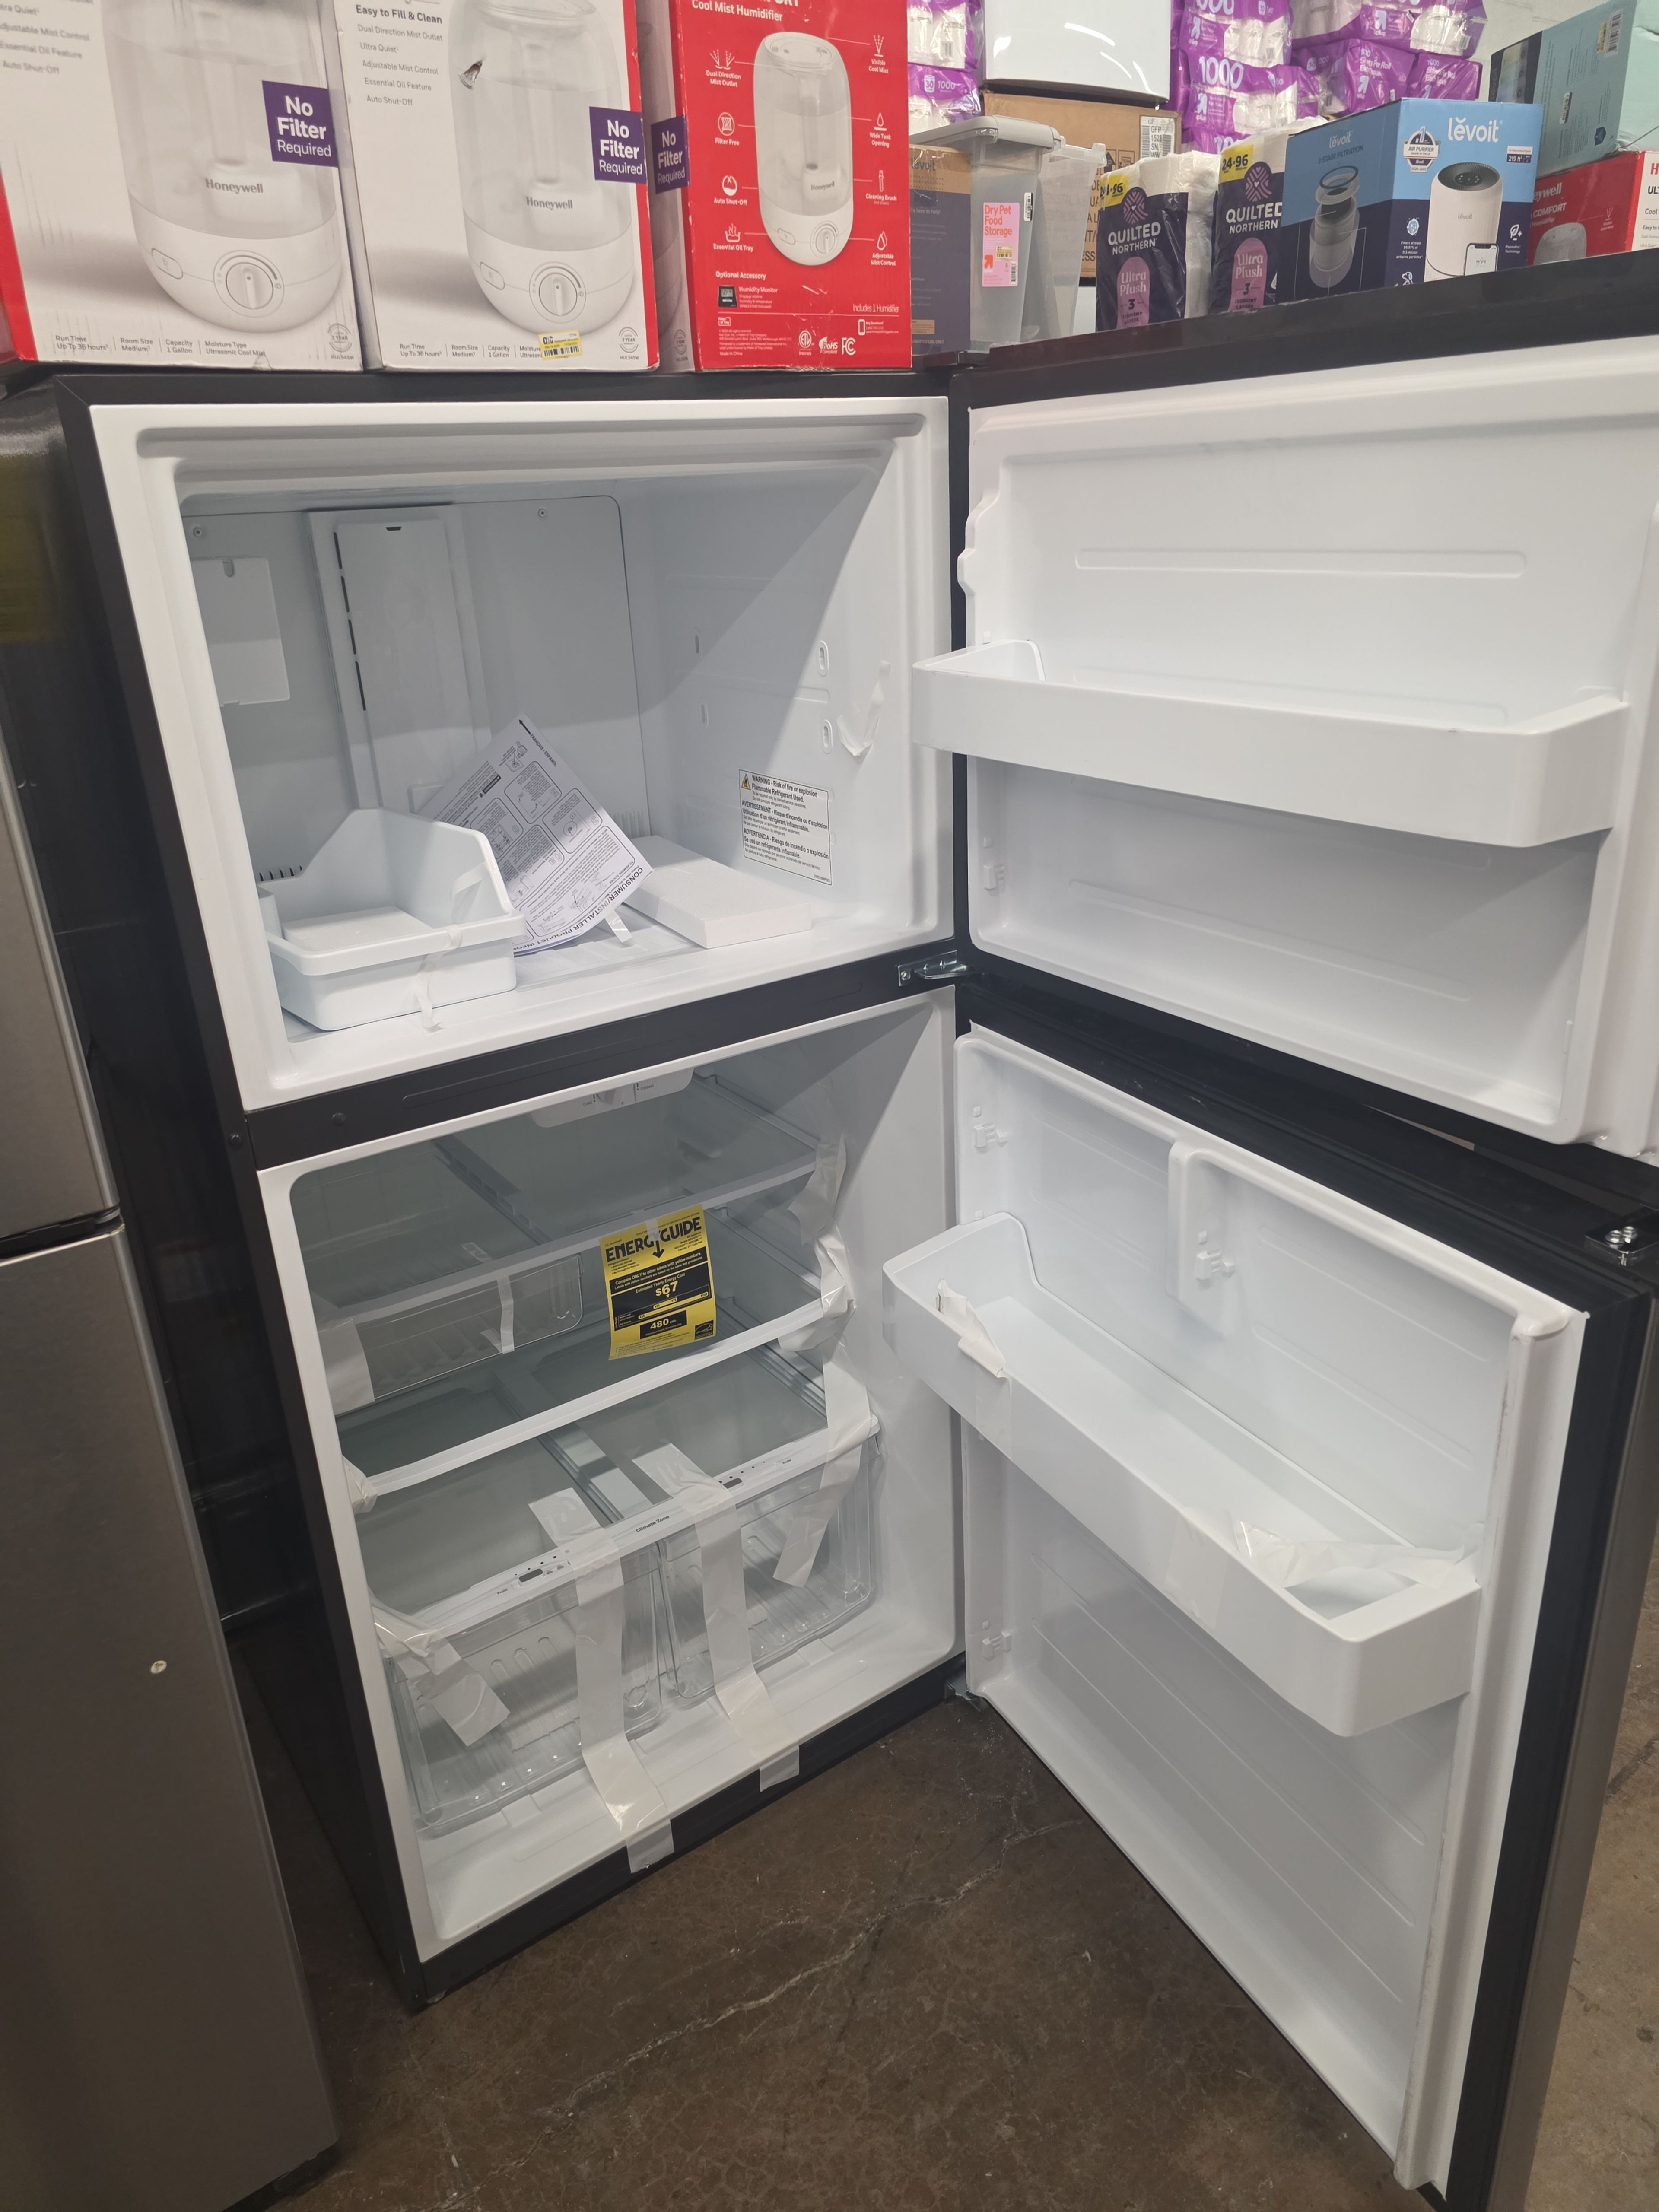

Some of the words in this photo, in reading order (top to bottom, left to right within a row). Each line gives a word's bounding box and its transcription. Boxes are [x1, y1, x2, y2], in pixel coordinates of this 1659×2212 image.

[356, 4, 377, 18] Easy
[391, 9, 406, 19] Fill
[408, 11, 415, 20] &
[417, 13, 442, 24] Clean
[692, 0, 713, 11] Cool
[715, 2, 734, 14] Mist
[737, 5, 783, 22] Humidifier
[358, 24, 374, 33] Dual
[375, 26, 405, 37] Direction
[407, 31, 421, 39] Mist
[423, 32, 442, 41] Outlet
[360, 42, 377, 51] Ultra
[362, 60, 397, 70] Adjustable
[415, 66, 438, 75] Control
[718, 70, 741, 79] Direction
[1199, 56, 1244, 89] 1000
[365, 77, 395, 87] Essential
[407, 83, 431, 91] Feature
[938, 81, 955, 89] 1000
[285, 96, 313, 116] No
[384, 97, 413, 106] Shut-Off
[277, 117, 326, 139] Filter
[607, 120, 629, 138] No
[662, 130, 676, 148] No
[872, 140, 889, 148] Opening
[277, 140, 331, 157] Required
[600, 140, 639, 159] Filter
[1339, 145, 1363, 159] FILTRATION
[658, 151, 683, 169] Filter
[599, 160, 642, 175] Required
[658, 167, 685, 185] Required
[205, 178, 263, 194] Honeywell
[811, 181, 834, 191] Honeywell
[526, 197, 573, 211] Honeywell
[866, 193, 884, 201] Cleaning
[985, 205, 998, 216] Dry
[1000, 205, 1011, 214] Pet
[1534, 202, 1567, 217] COMFORT
[985, 216, 1002, 225] Food
[1230, 219, 1278, 234] NORTHERN
[985, 226, 1012, 238] Storage
[1108, 222, 1161, 245] QUILTED
[1112, 238, 1156, 255] NORTHERN
[1237, 254, 1263, 266] Ultra
[740, 272, 766, 281] Accessory
[1121, 272, 1146, 284] Ultra
[1235, 267, 1262, 279] Plush
[1120, 282, 1146, 296] Plush
[1243, 283, 1250, 295] 3
[853, 304, 871, 312] Includes
[873, 304, 876, 312] 1
[877, 304, 899, 313] Humidifier
[1128, 299, 1135, 310] 3
[752, 775, 770, 785] WARNING
[799, 788, 817, 798] explosion
[752, 783, 771, 794] Flammable
[772, 790, 792, 799] Refrigerant
[742, 801, 771, 813] AVERTISSEMENT
[744, 828, 769, 840] ADVERTENCIA
[533, 928, 573, 944] PRODUCT
[636, 1283, 652, 1294] Estimated
[653, 1279, 664, 1287] Yearly
[665, 1275, 677, 1284] Energy
[656, 1281, 678, 1297] $67
[650, 1319, 669, 1329] 480
[636, 1522, 656, 1532] Climate
